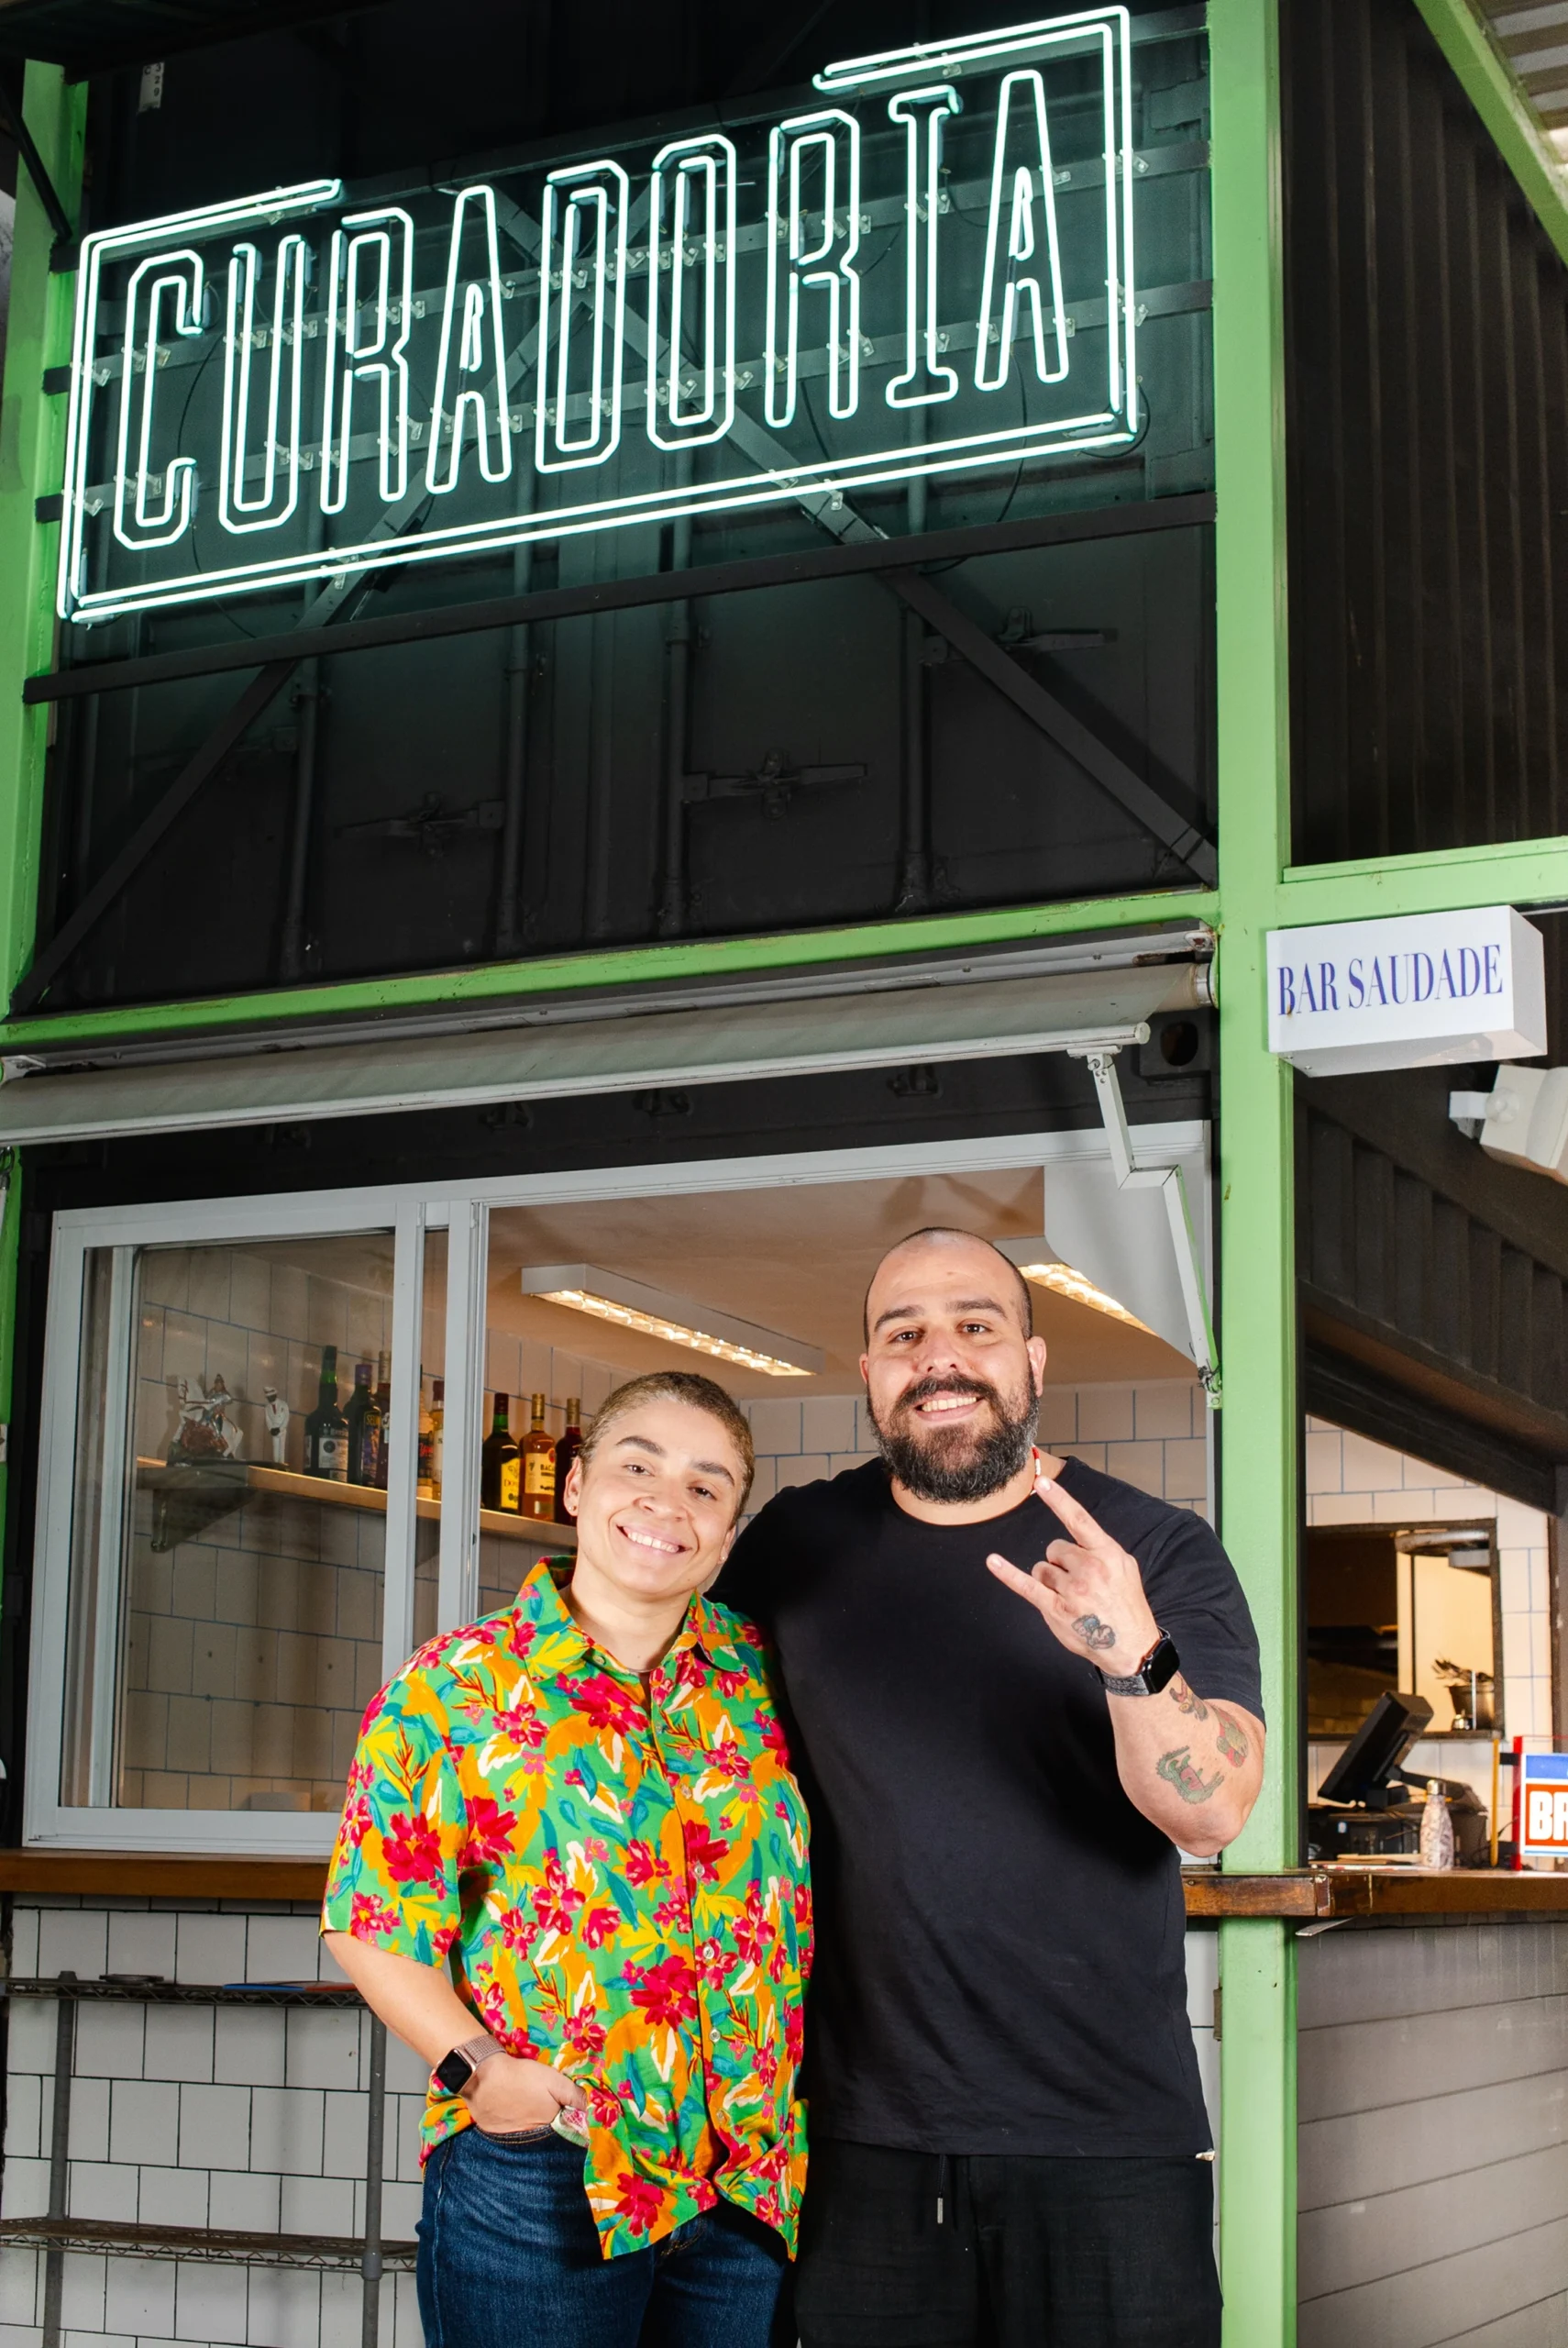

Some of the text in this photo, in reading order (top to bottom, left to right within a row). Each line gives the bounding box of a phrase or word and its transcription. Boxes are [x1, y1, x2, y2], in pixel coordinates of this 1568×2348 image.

[114, 68, 1070, 550] CURADORIA
[1277, 944, 1504, 1016] BAR SAUDADE
